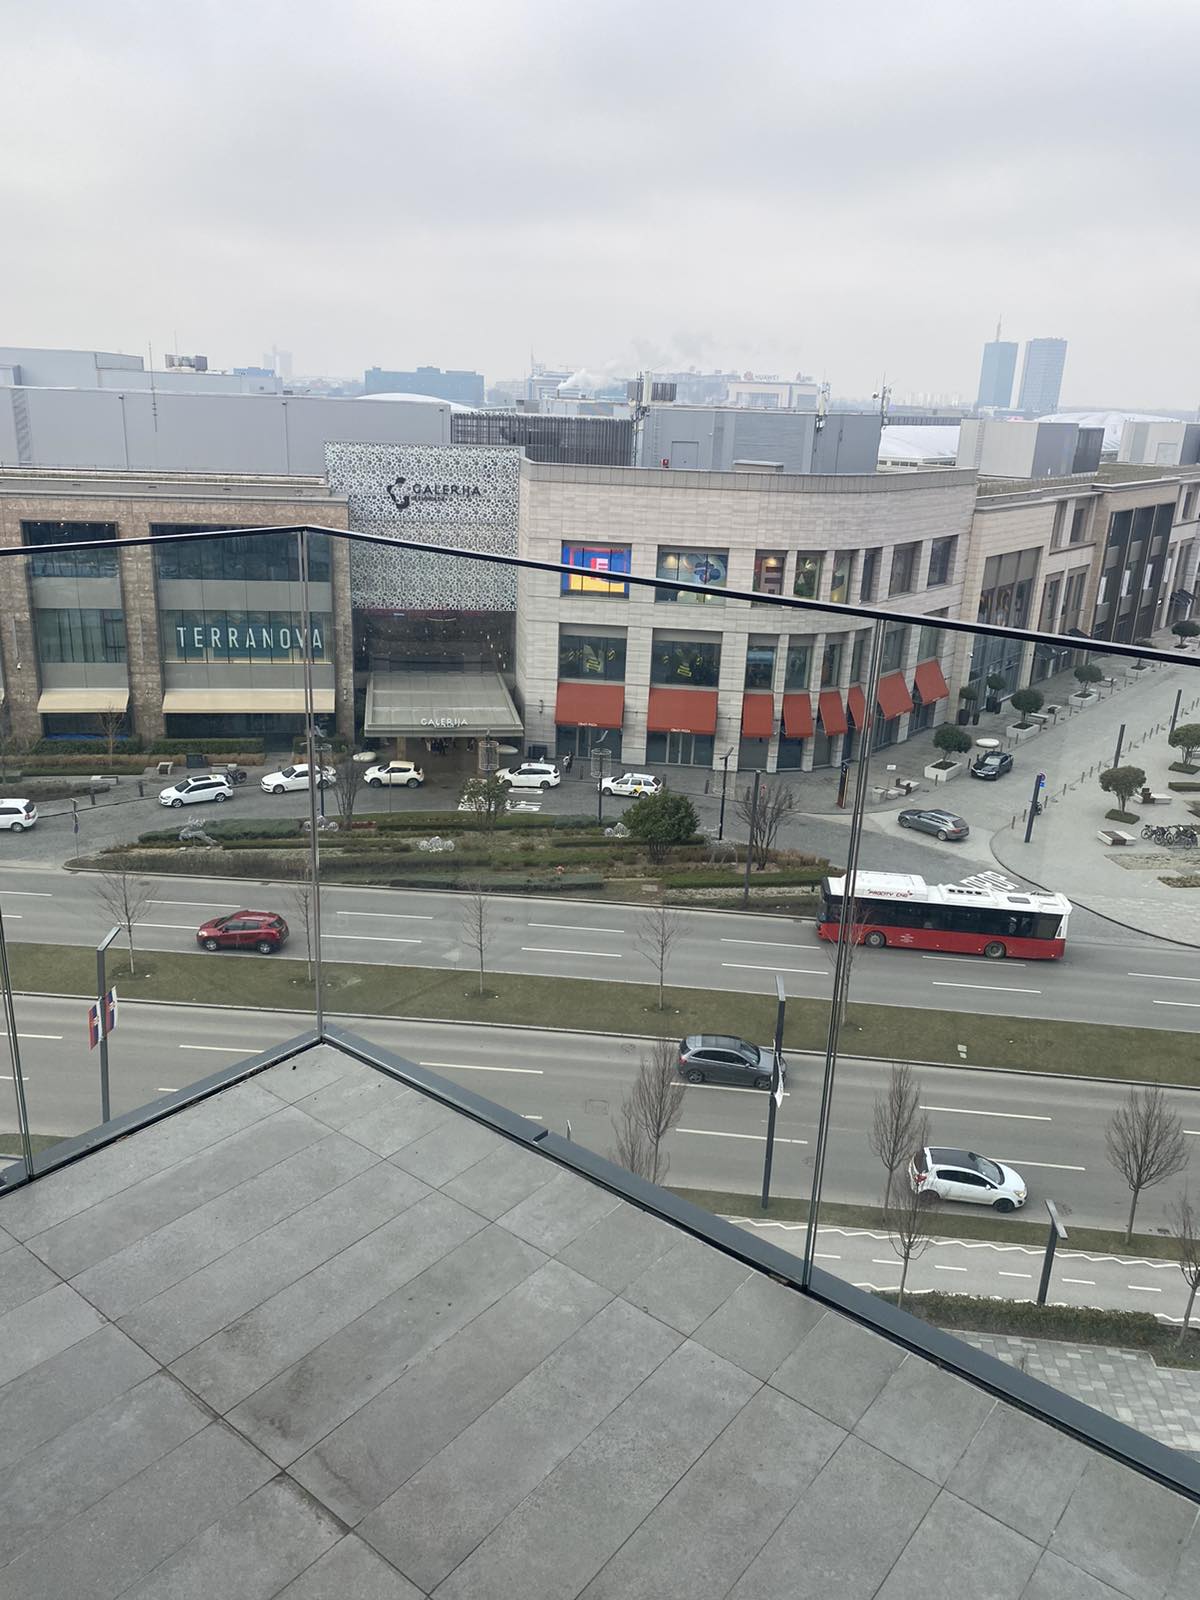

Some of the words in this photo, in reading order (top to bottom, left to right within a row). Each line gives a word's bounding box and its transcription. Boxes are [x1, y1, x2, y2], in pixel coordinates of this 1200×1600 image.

[412, 483, 481, 498] GALERIJA
[176, 627, 322, 649] TERRANOVA
[420, 718, 469, 727] GALERIJA
